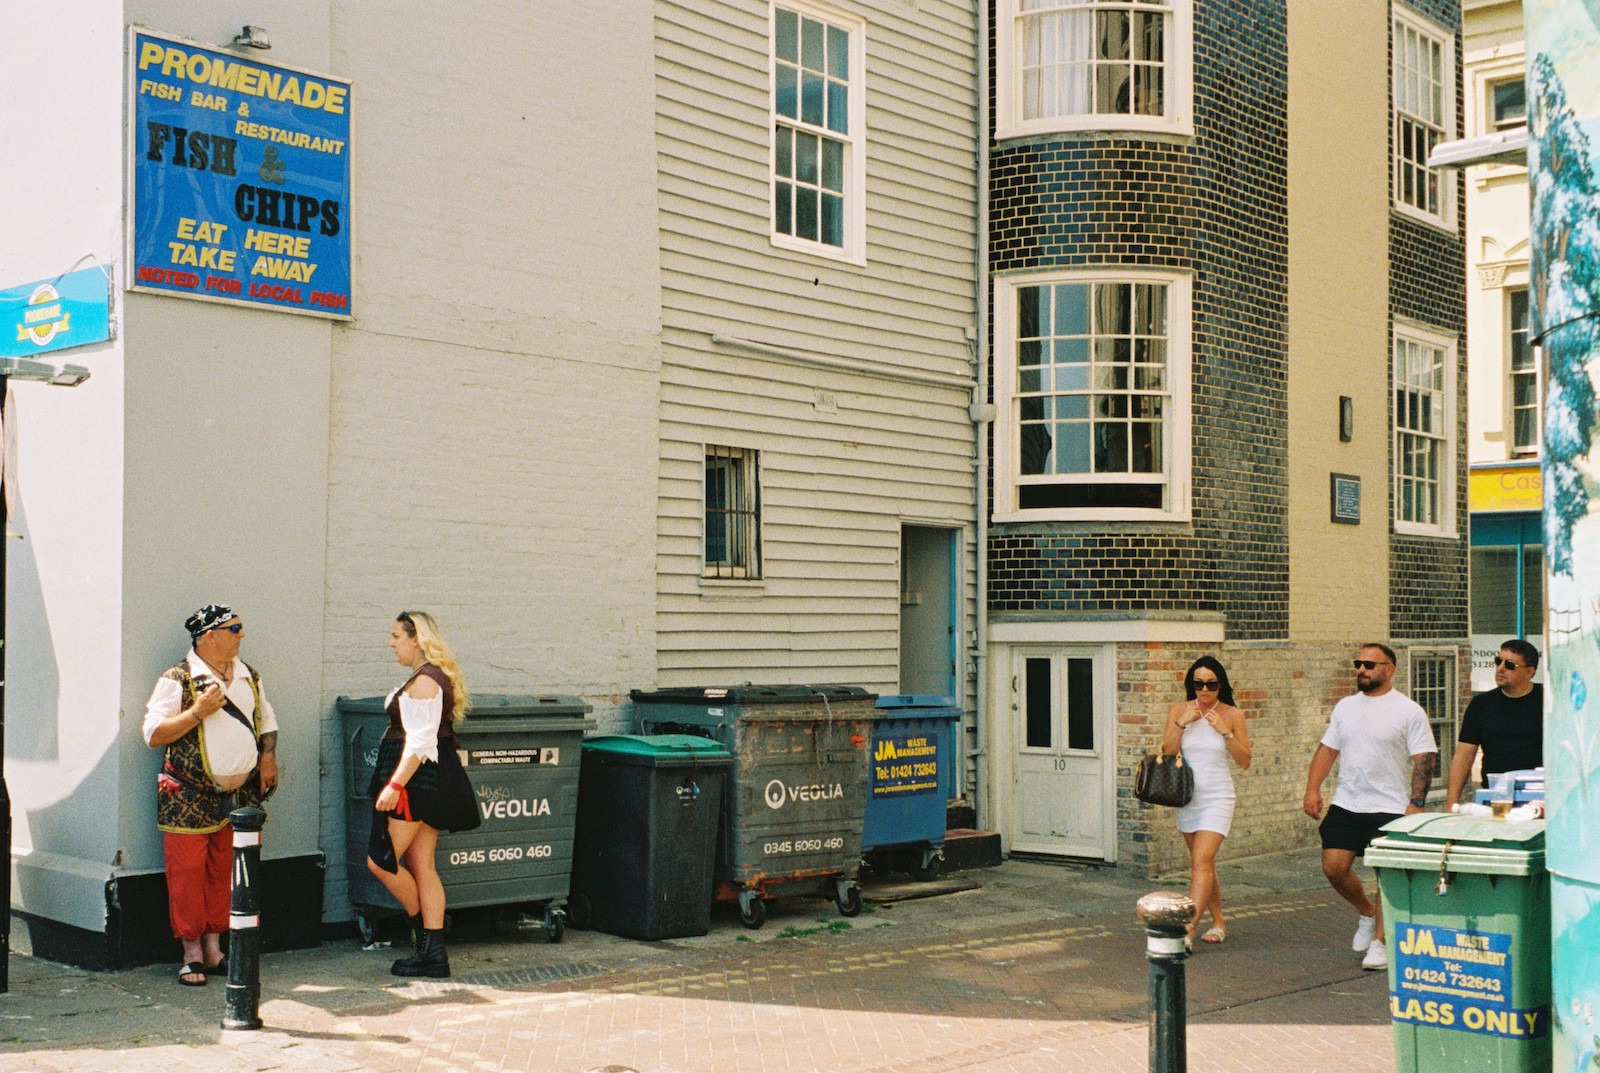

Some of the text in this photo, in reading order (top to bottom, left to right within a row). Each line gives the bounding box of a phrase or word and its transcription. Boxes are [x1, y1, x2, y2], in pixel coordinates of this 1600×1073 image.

[138, 41, 348, 115] PROMENADE
[140, 79, 250, 118] FISH BAR &
[235, 120, 345, 155] RESTAURANT
[147, 121, 286, 186] FISH &
[234, 183, 340, 237] CHIPS
[176, 217, 312, 259] EAT HERE
[168, 241, 318, 283] TAKE AWAY
[137, 265, 348, 309] NOTED FOR LOCAL FISH
[472, 749, 538, 758] GENERAL NON-HAZARDOUS
[874, 740, 937, 761] JM MANAGEMENT
[906, 737, 928, 748] WASTE
[514, 756, 532, 764] WASTE
[875, 762, 937, 780] Tel: 01424 732643
[1053, 759, 1066, 771] 10
[788, 783, 844, 802] VEOLIA
[480, 798, 552, 820] VEOLIA
[450, 845, 552, 865] 0345 6060 460
[764, 837, 844, 854] 0345 6060 460
[1399, 928, 1490, 957] JM WASTE
[1437, 945, 1507, 966] MANAGEMENT
[1443, 961, 1463, 973] Tel:
[1404, 967, 1502, 992] 01424 732643
[1390, 995, 1538, 1036] LASS ONLY
